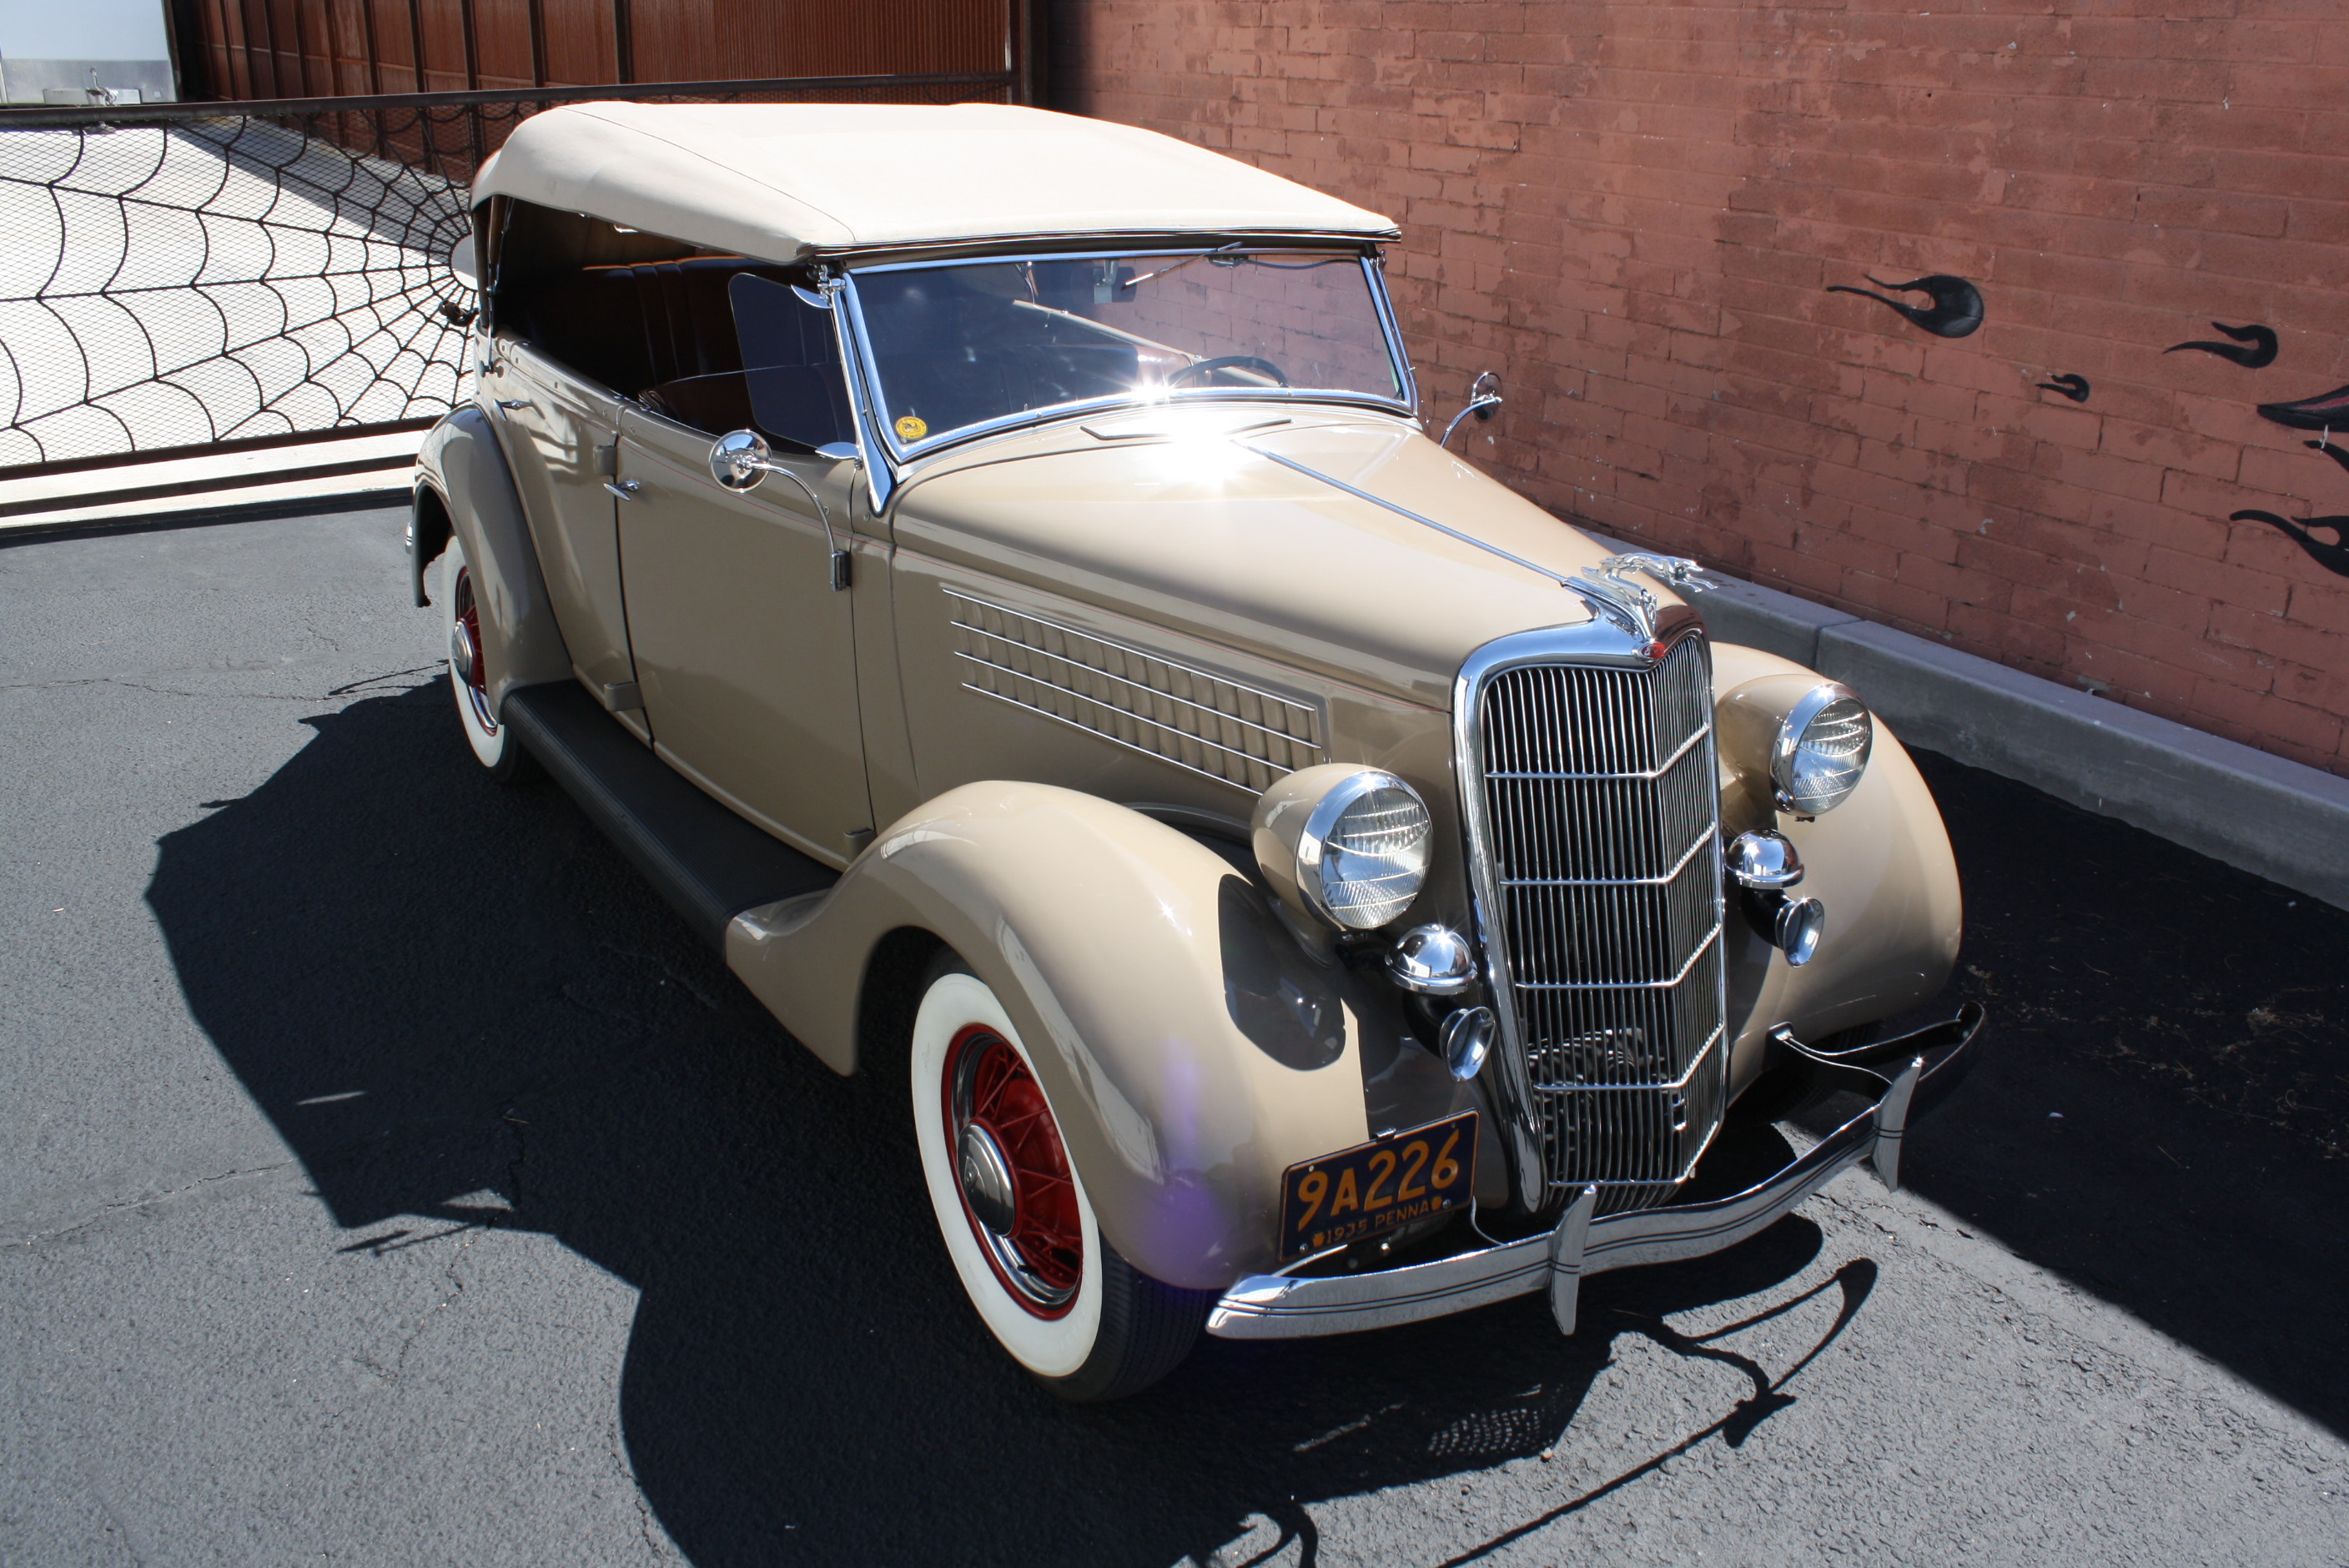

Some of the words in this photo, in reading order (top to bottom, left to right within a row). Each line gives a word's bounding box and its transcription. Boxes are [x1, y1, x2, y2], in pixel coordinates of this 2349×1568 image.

[1298, 1129, 1460, 1231] 9A226
[1325, 1219, 1367, 1244] 1935
[1376, 1200, 1429, 1229] PENNA
